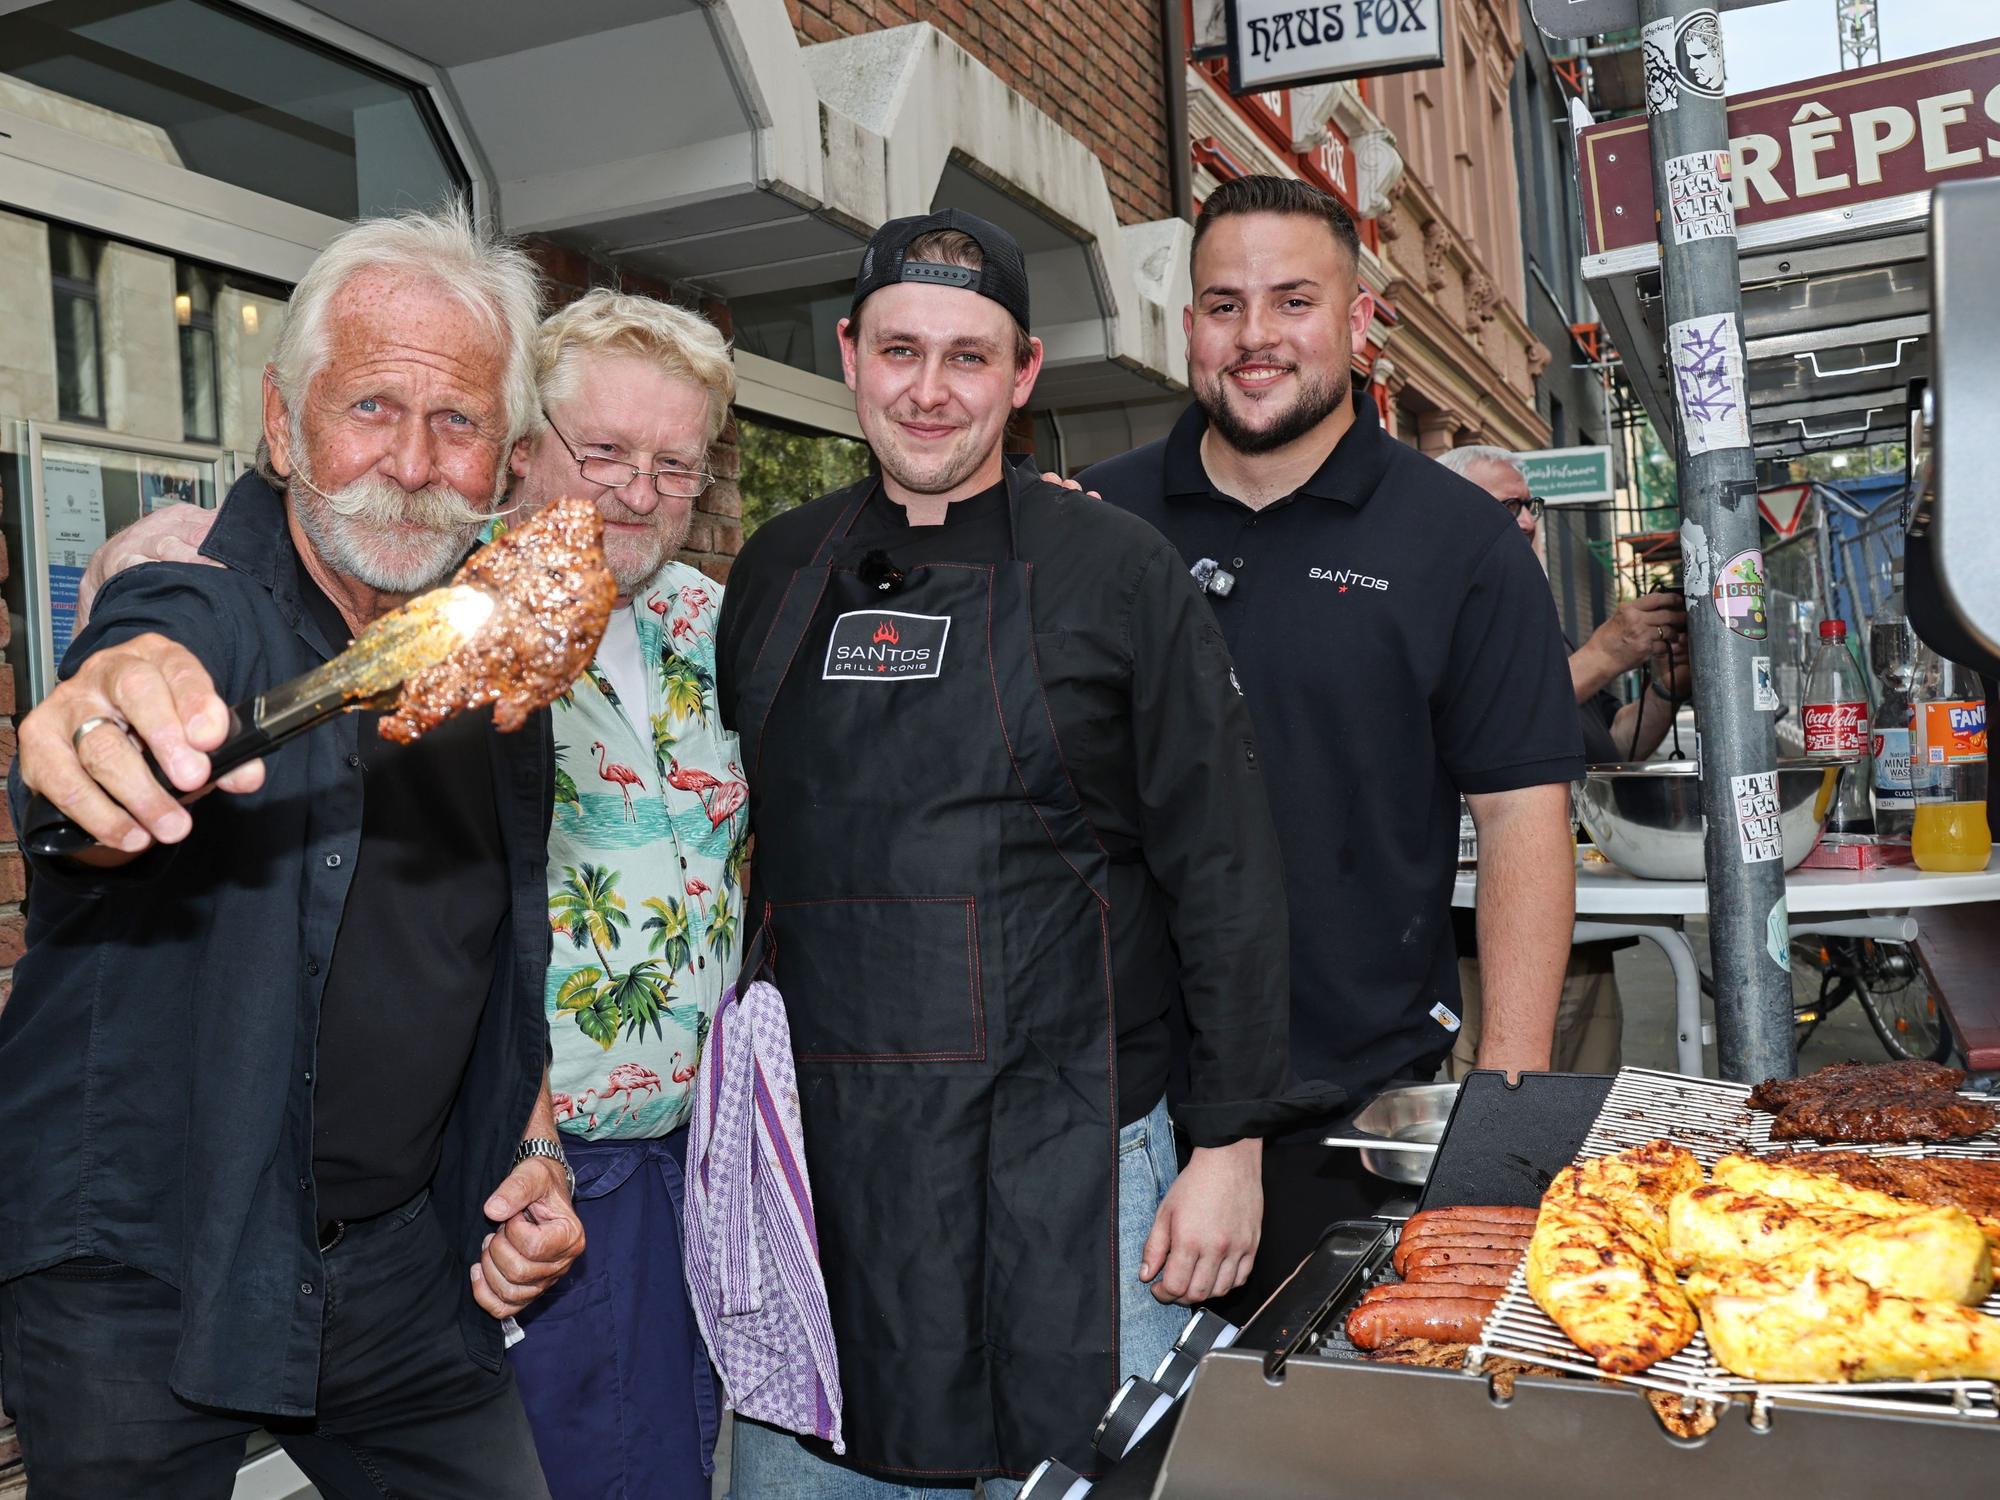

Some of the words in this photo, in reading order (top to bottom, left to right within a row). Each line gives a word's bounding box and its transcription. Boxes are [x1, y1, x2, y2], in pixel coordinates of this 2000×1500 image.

[1247, 4, 1345, 62] HAUS
[1354, 0, 1427, 38] FOX
[1728, 83, 2000, 210] RÊPE
[1309, 568, 1389, 591] SANTOS
[1719, 583, 1765, 599] LÖSCH
[837, 644, 930, 662] SANTOS
[835, 663, 874, 671] GRILL
[1805, 706, 1859, 728] Coca-Cola
[1949, 704, 1986, 728] FANT
[1884, 758, 1910, 769] MINE
